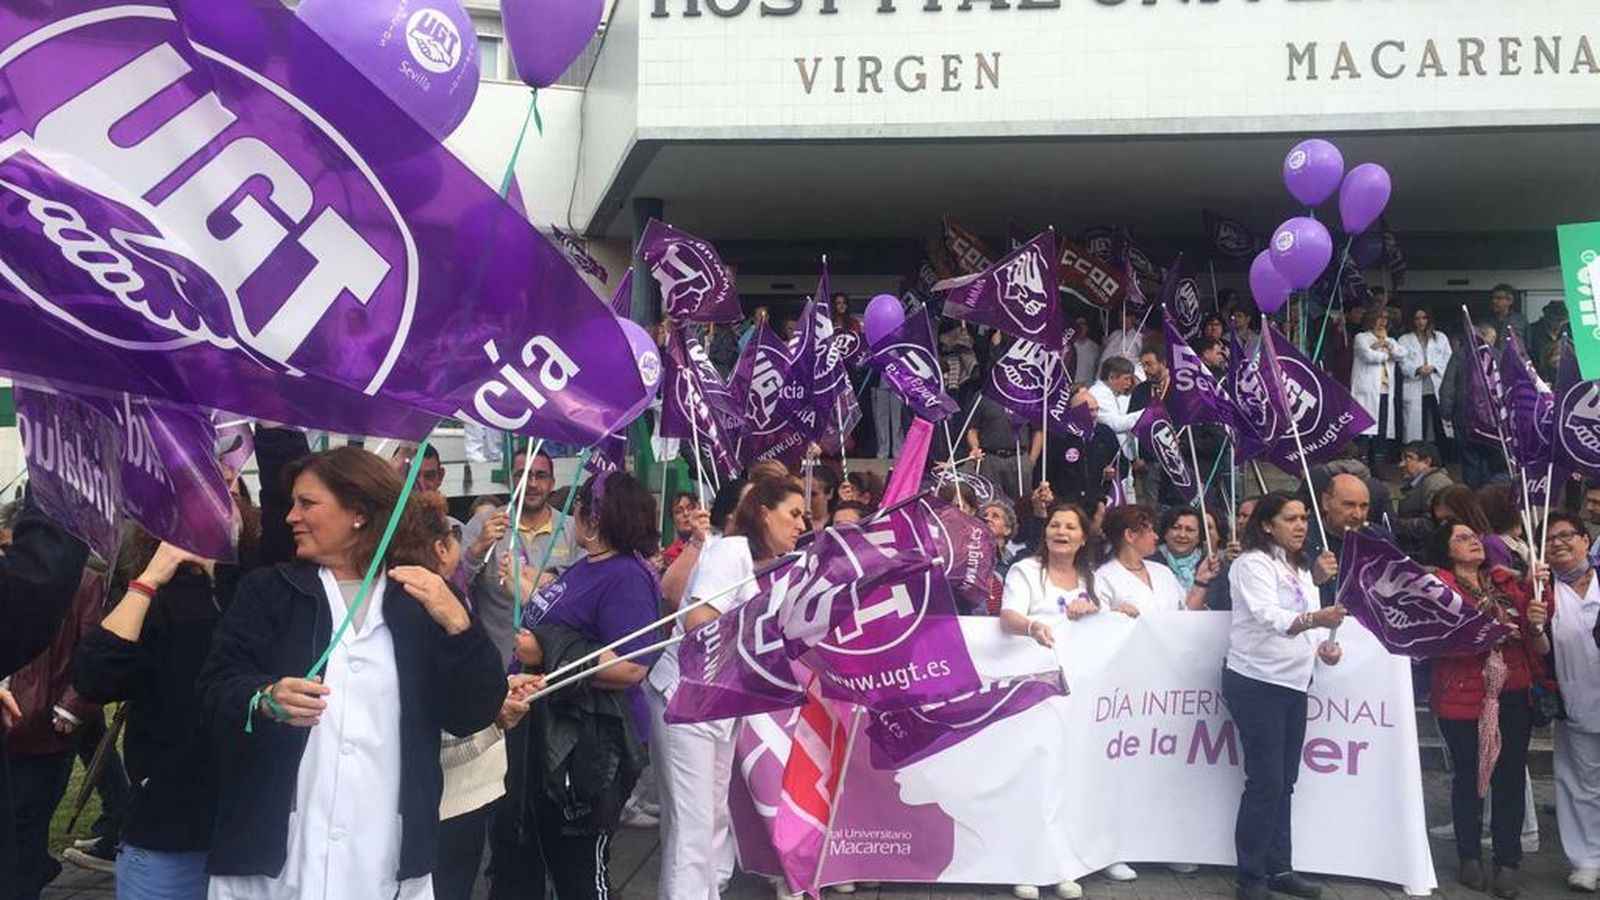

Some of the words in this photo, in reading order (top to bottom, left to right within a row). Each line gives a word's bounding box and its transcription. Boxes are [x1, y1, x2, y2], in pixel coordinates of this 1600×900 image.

[413, 11, 459, 57] UGT
[399, 60, 432, 92] Sevilla
[795, 52, 1000, 94] VIRGEN
[1286, 34, 1600, 81] MACARENA
[33, 41, 392, 375] UGT
[1060, 248, 1120, 297] CCOO
[1096, 687, 1133, 722] DÍA
[1142, 689, 1395, 728] INTERNONAL
[1106, 730, 1141, 759] de
[1150, 728, 1178, 755] la
[1186, 719, 1370, 776] Mer
[829, 840, 912, 856] Macarena
[844, 828, 913, 840] Universitario
